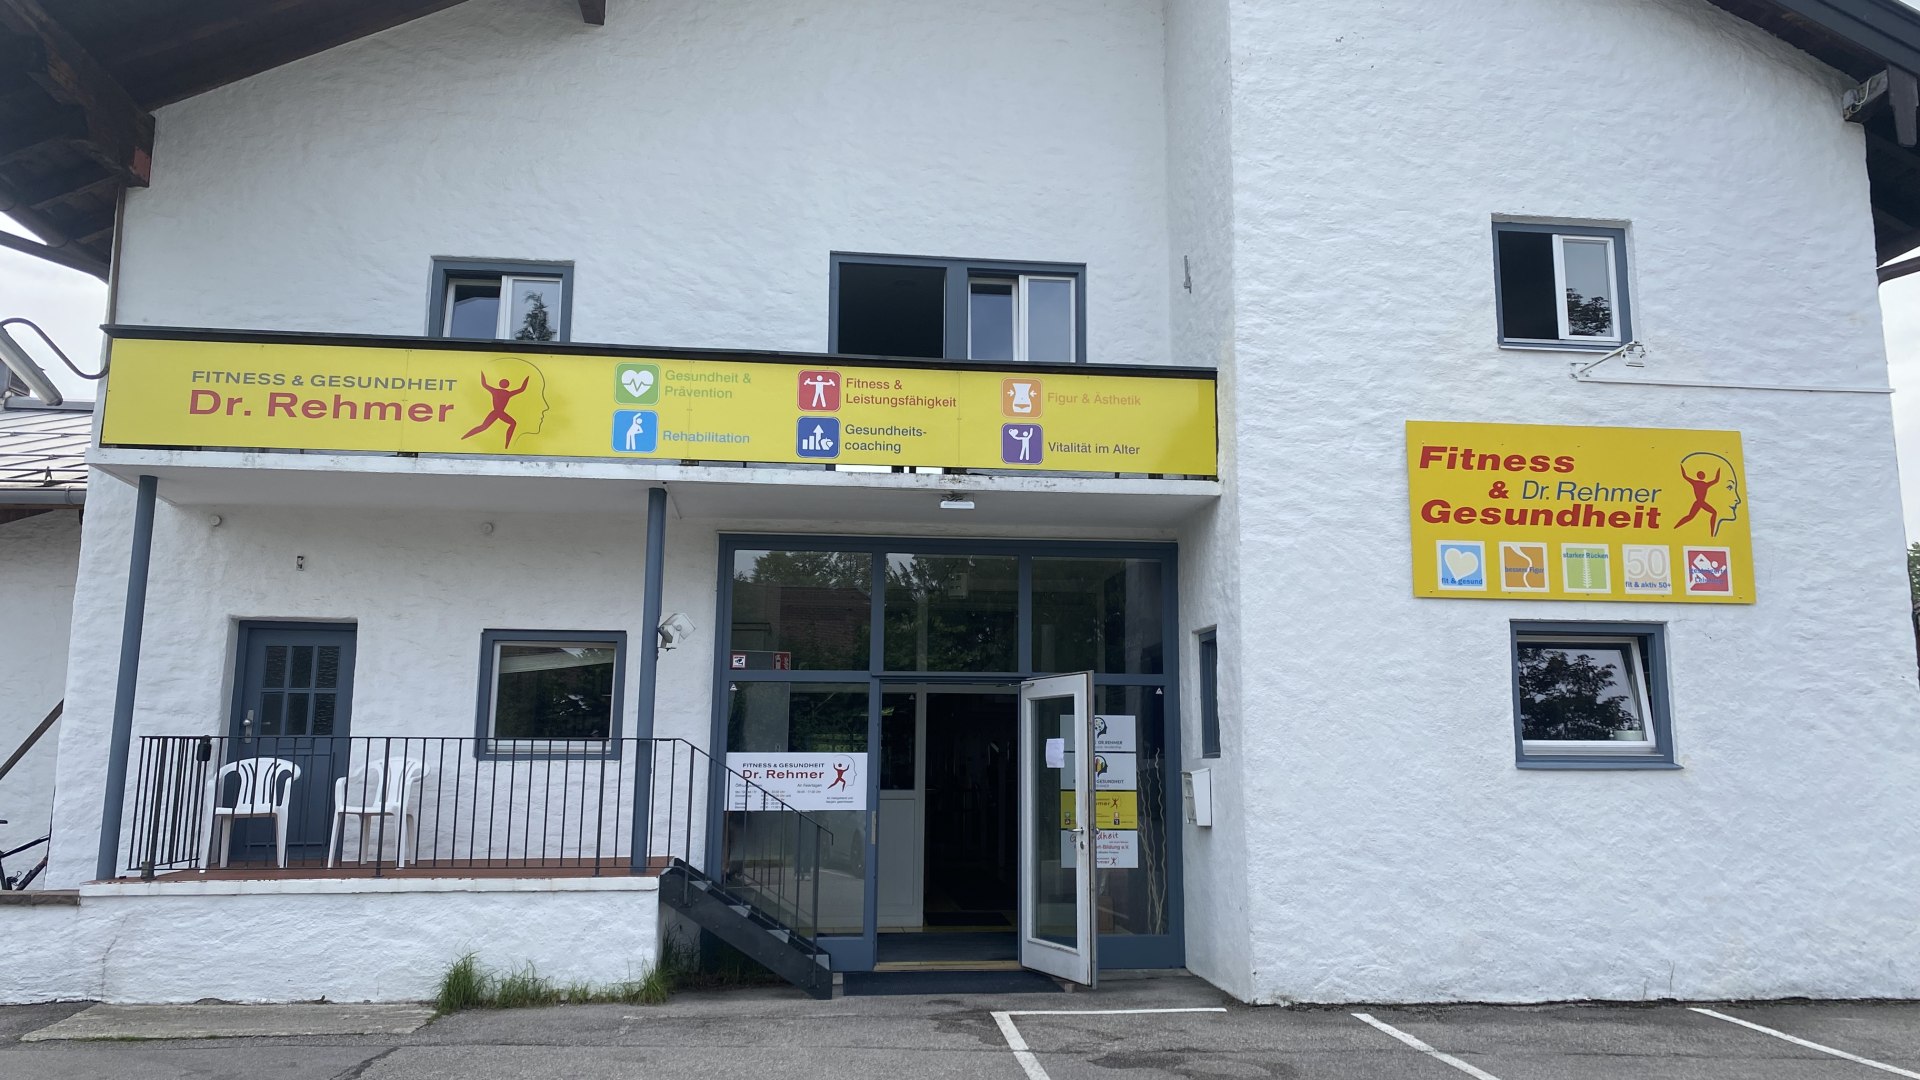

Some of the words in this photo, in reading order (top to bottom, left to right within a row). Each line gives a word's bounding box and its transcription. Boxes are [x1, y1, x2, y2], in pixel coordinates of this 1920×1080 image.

[191, 370, 286, 386] FITNESS
[291, 374, 305, 386] &
[310, 374, 458, 392] GESUNDHEIT
[664, 370, 738, 384] Gesundheit
[742, 373, 752, 384] &
[846, 378, 890, 390] Fitness
[893, 379, 903, 390] &
[664, 385, 733, 399] Prävention
[1047, 392, 1078, 406] Figur
[1081, 393, 1091, 405] &
[1094, 392, 1141, 406] Ästhetik
[189, 389, 252, 417] Dr.
[267, 391, 455, 423] Rehmer
[845, 393, 957, 409] Leistungsfähigkeit
[662, 430, 750, 444] Rehabilitation
[844, 424, 927, 437] Gesundheits-
[844, 440, 902, 454] coaching
[1048, 441, 1091, 454] Vitalität
[1095, 443, 1109, 454] im
[1113, 443, 1141, 455] Alter
[1419, 445, 1575, 473] Fitness
[1488, 480, 1509, 500] &
[1522, 480, 1550, 501] Dr.
[1556, 481, 1662, 503] Rehmer
[1420, 499, 1662, 529] Gesundheit
[1627, 548, 1668, 578] 50
[1441, 577, 1449, 585] fit
[1458, 578, 1483, 586] gesund
[742, 769, 762, 779] Dr.
[766, 769, 825, 779] Rehmer
